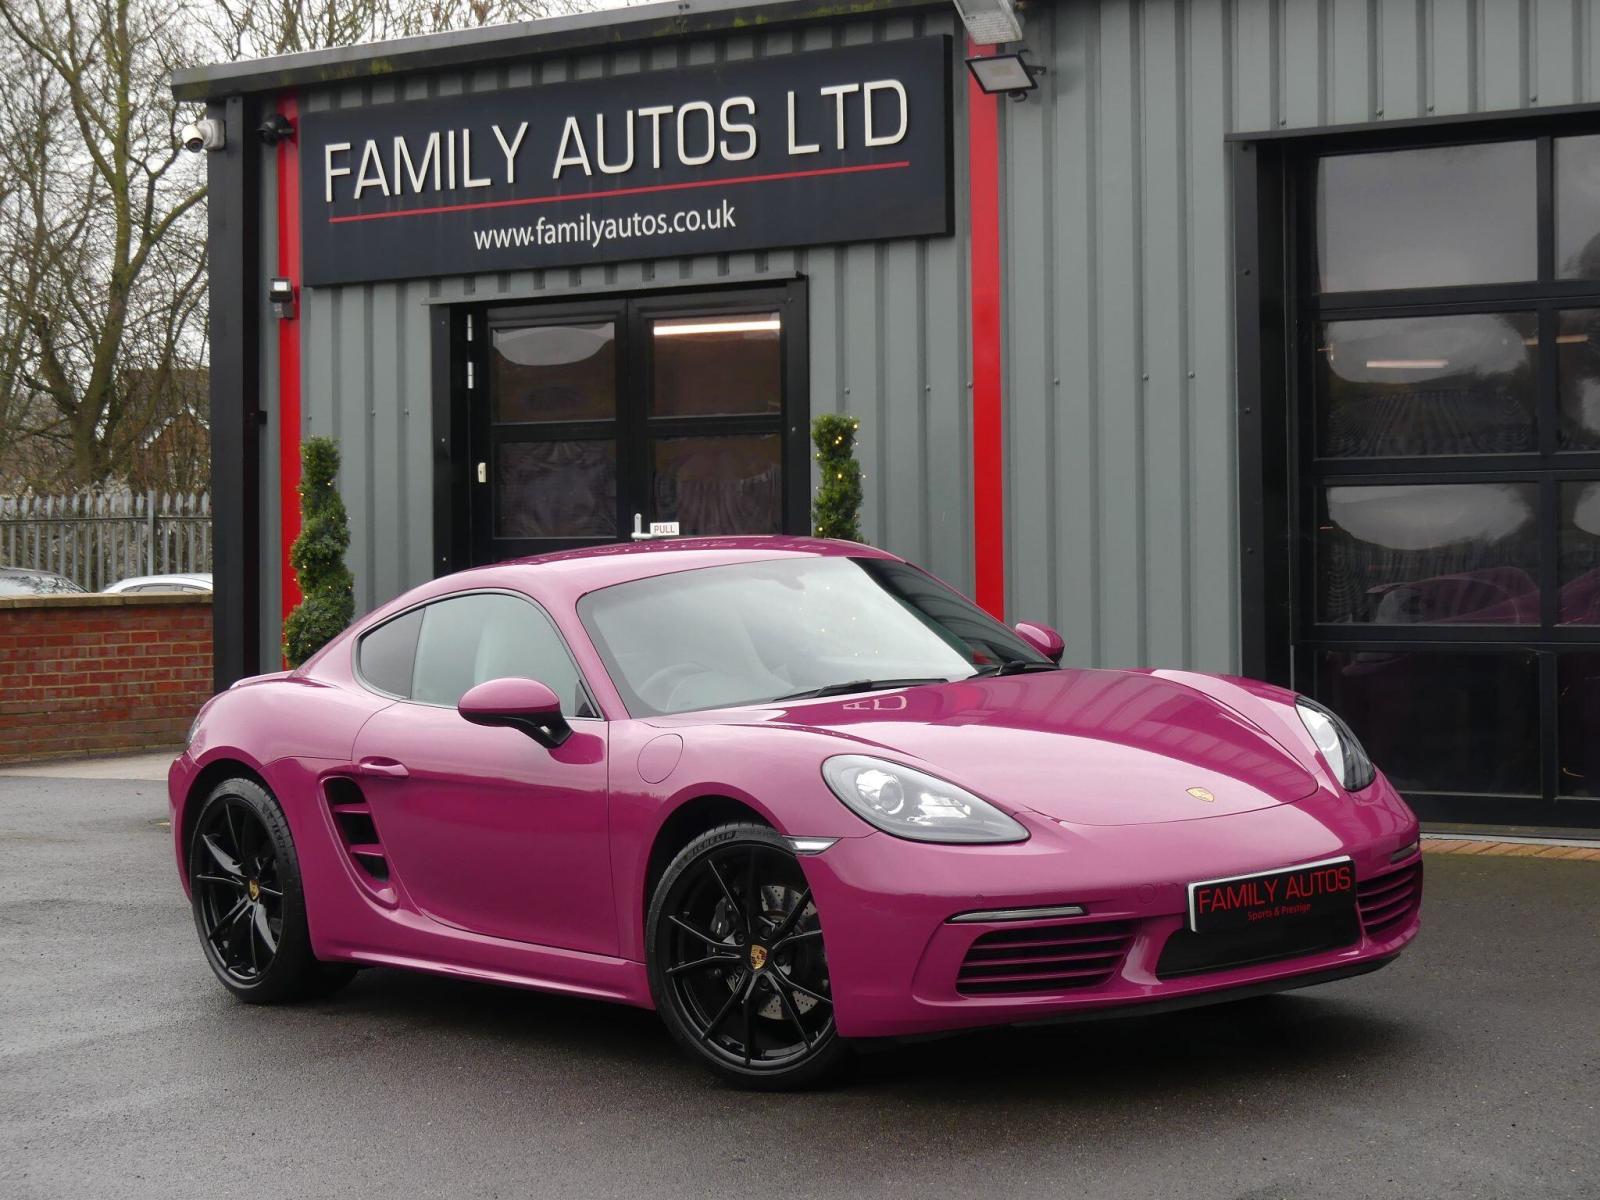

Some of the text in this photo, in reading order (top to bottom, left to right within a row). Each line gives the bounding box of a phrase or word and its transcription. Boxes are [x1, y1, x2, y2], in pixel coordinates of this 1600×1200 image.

[324, 78, 909, 203] FAMILY AUTOS LTD
[473, 199, 737, 250] www.familyautos.co.uk
[653, 524, 675, 534] PULL
[1199, 867, 1350, 913] FAMILY AUTOS
[1247, 902, 1312, 921] Sports & Prestige
